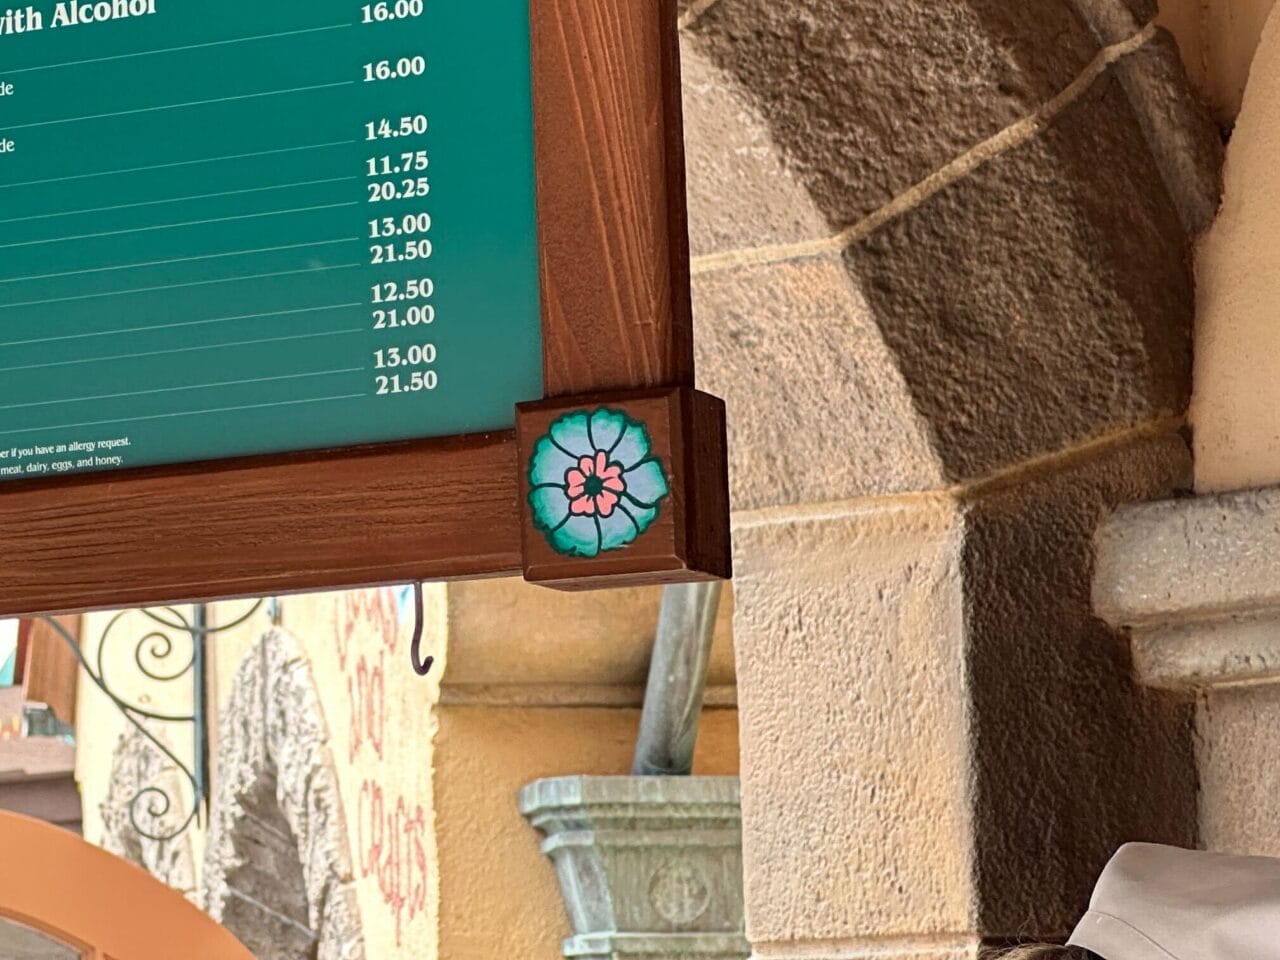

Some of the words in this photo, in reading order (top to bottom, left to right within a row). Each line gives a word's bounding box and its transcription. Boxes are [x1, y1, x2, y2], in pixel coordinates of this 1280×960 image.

[363, 55, 426, 82] 16.00
[365, 114, 428, 141] 14.50
[366, 150, 429, 177] 11.75
[367, 177, 430, 203] 20.25
[368, 212, 431, 238] 13.00
[369, 239, 432, 265] 21.50
[371, 278, 434, 304] 12.50
[372, 304, 435, 330] 21.00
[373, 343, 437, 369] 13.00
[375, 370, 438, 395] 21.50
[17, 448, 34, 459] you
[34, 445, 55, 455] have
[55, 444, 67, 453] an
[68, 441, 96, 452] allergy
[76, 456, 94, 468] and
